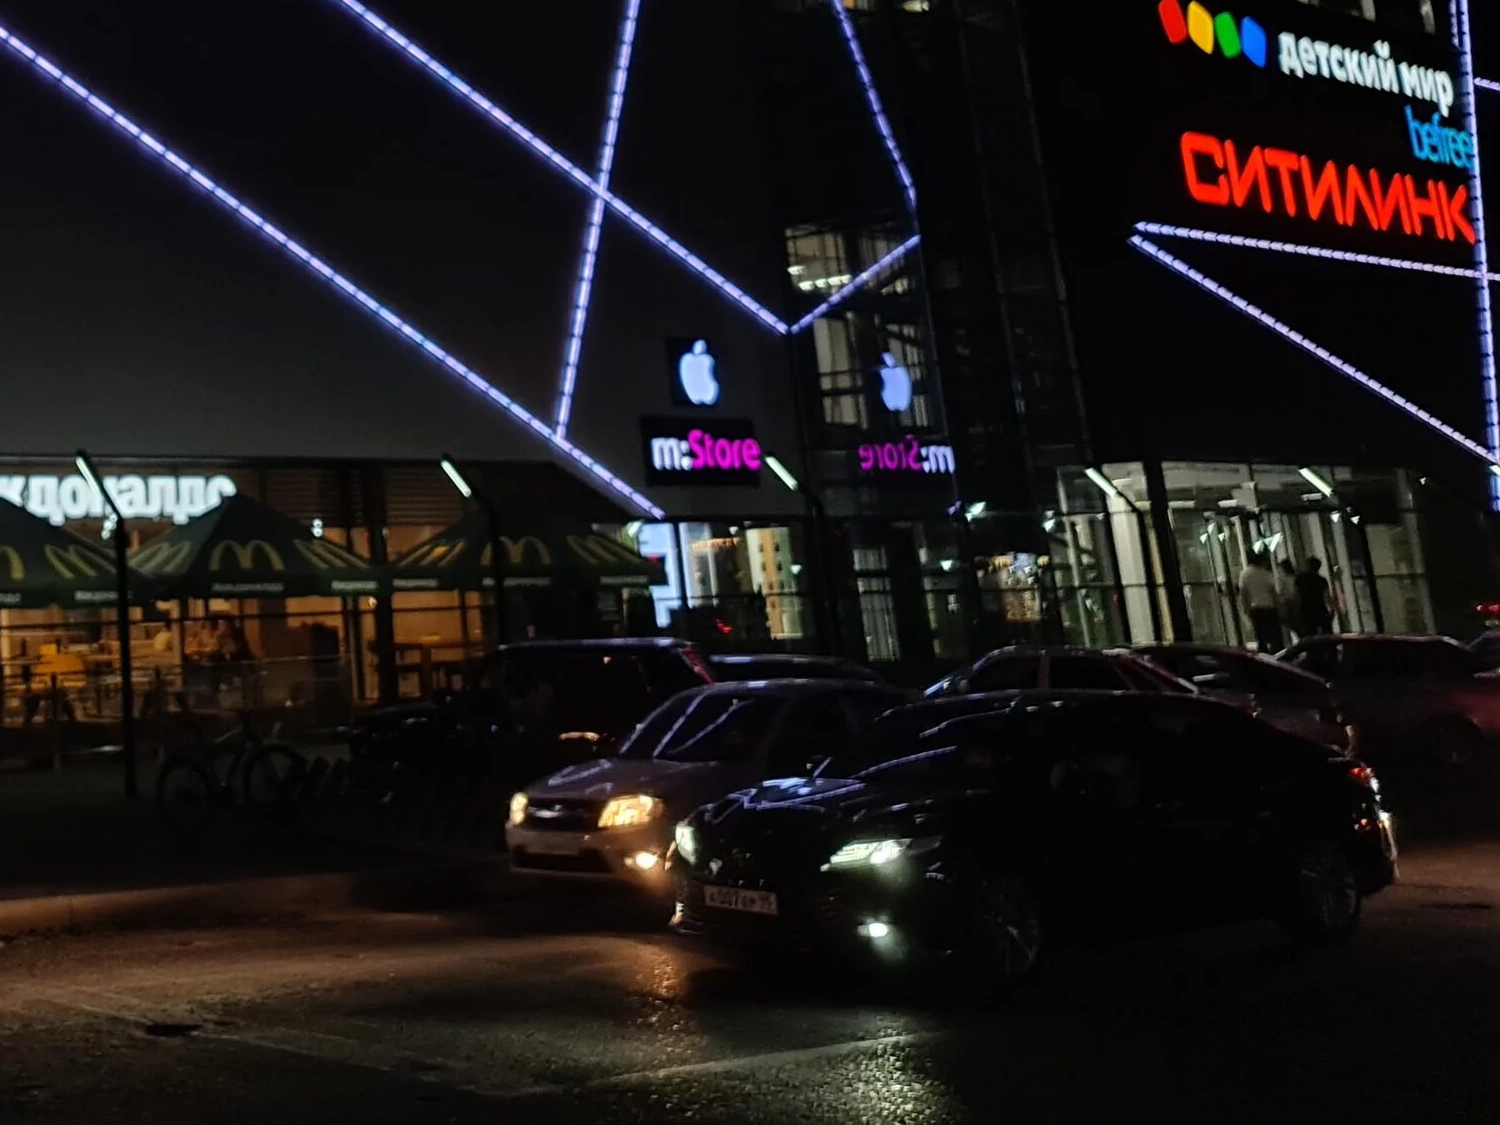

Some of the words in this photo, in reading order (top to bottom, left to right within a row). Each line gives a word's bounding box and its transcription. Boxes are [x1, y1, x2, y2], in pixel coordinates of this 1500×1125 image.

[1405, 105, 1474, 172] befree
[1180, 131, 1477, 245] СИТИЛИНК
[651, 429, 762, 471] m:Store
